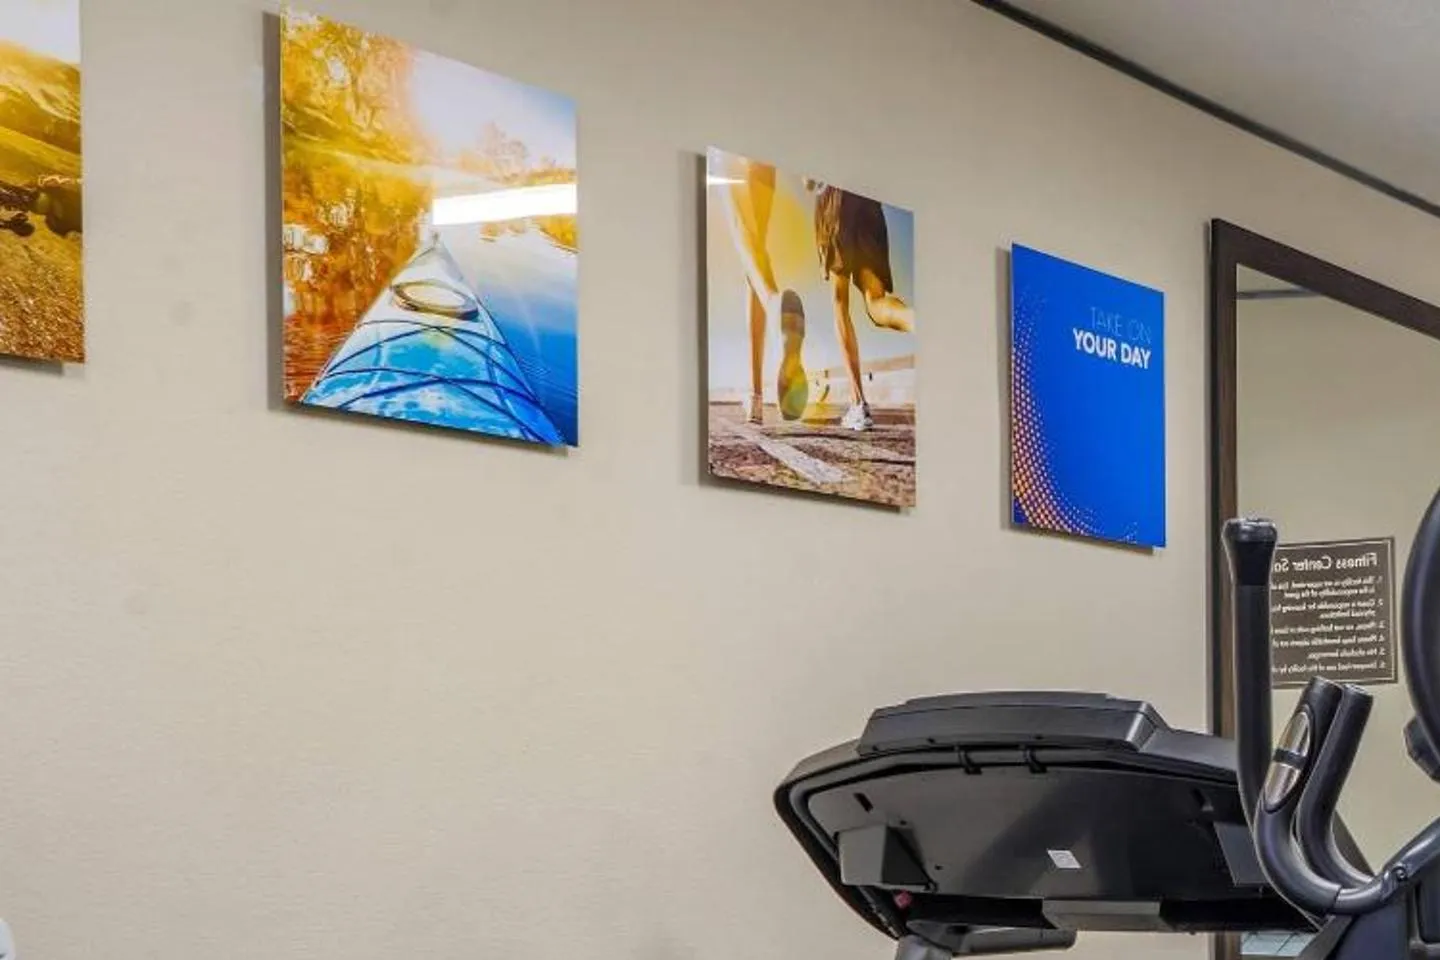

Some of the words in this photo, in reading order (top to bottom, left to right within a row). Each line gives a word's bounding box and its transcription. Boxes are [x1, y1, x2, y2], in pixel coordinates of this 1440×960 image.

[1090, 306, 1122, 337] TAKE
[1128, 319, 1152, 346] ON
[1073, 328, 1117, 361] YOUR
[1120, 341, 1152, 370] DAY
